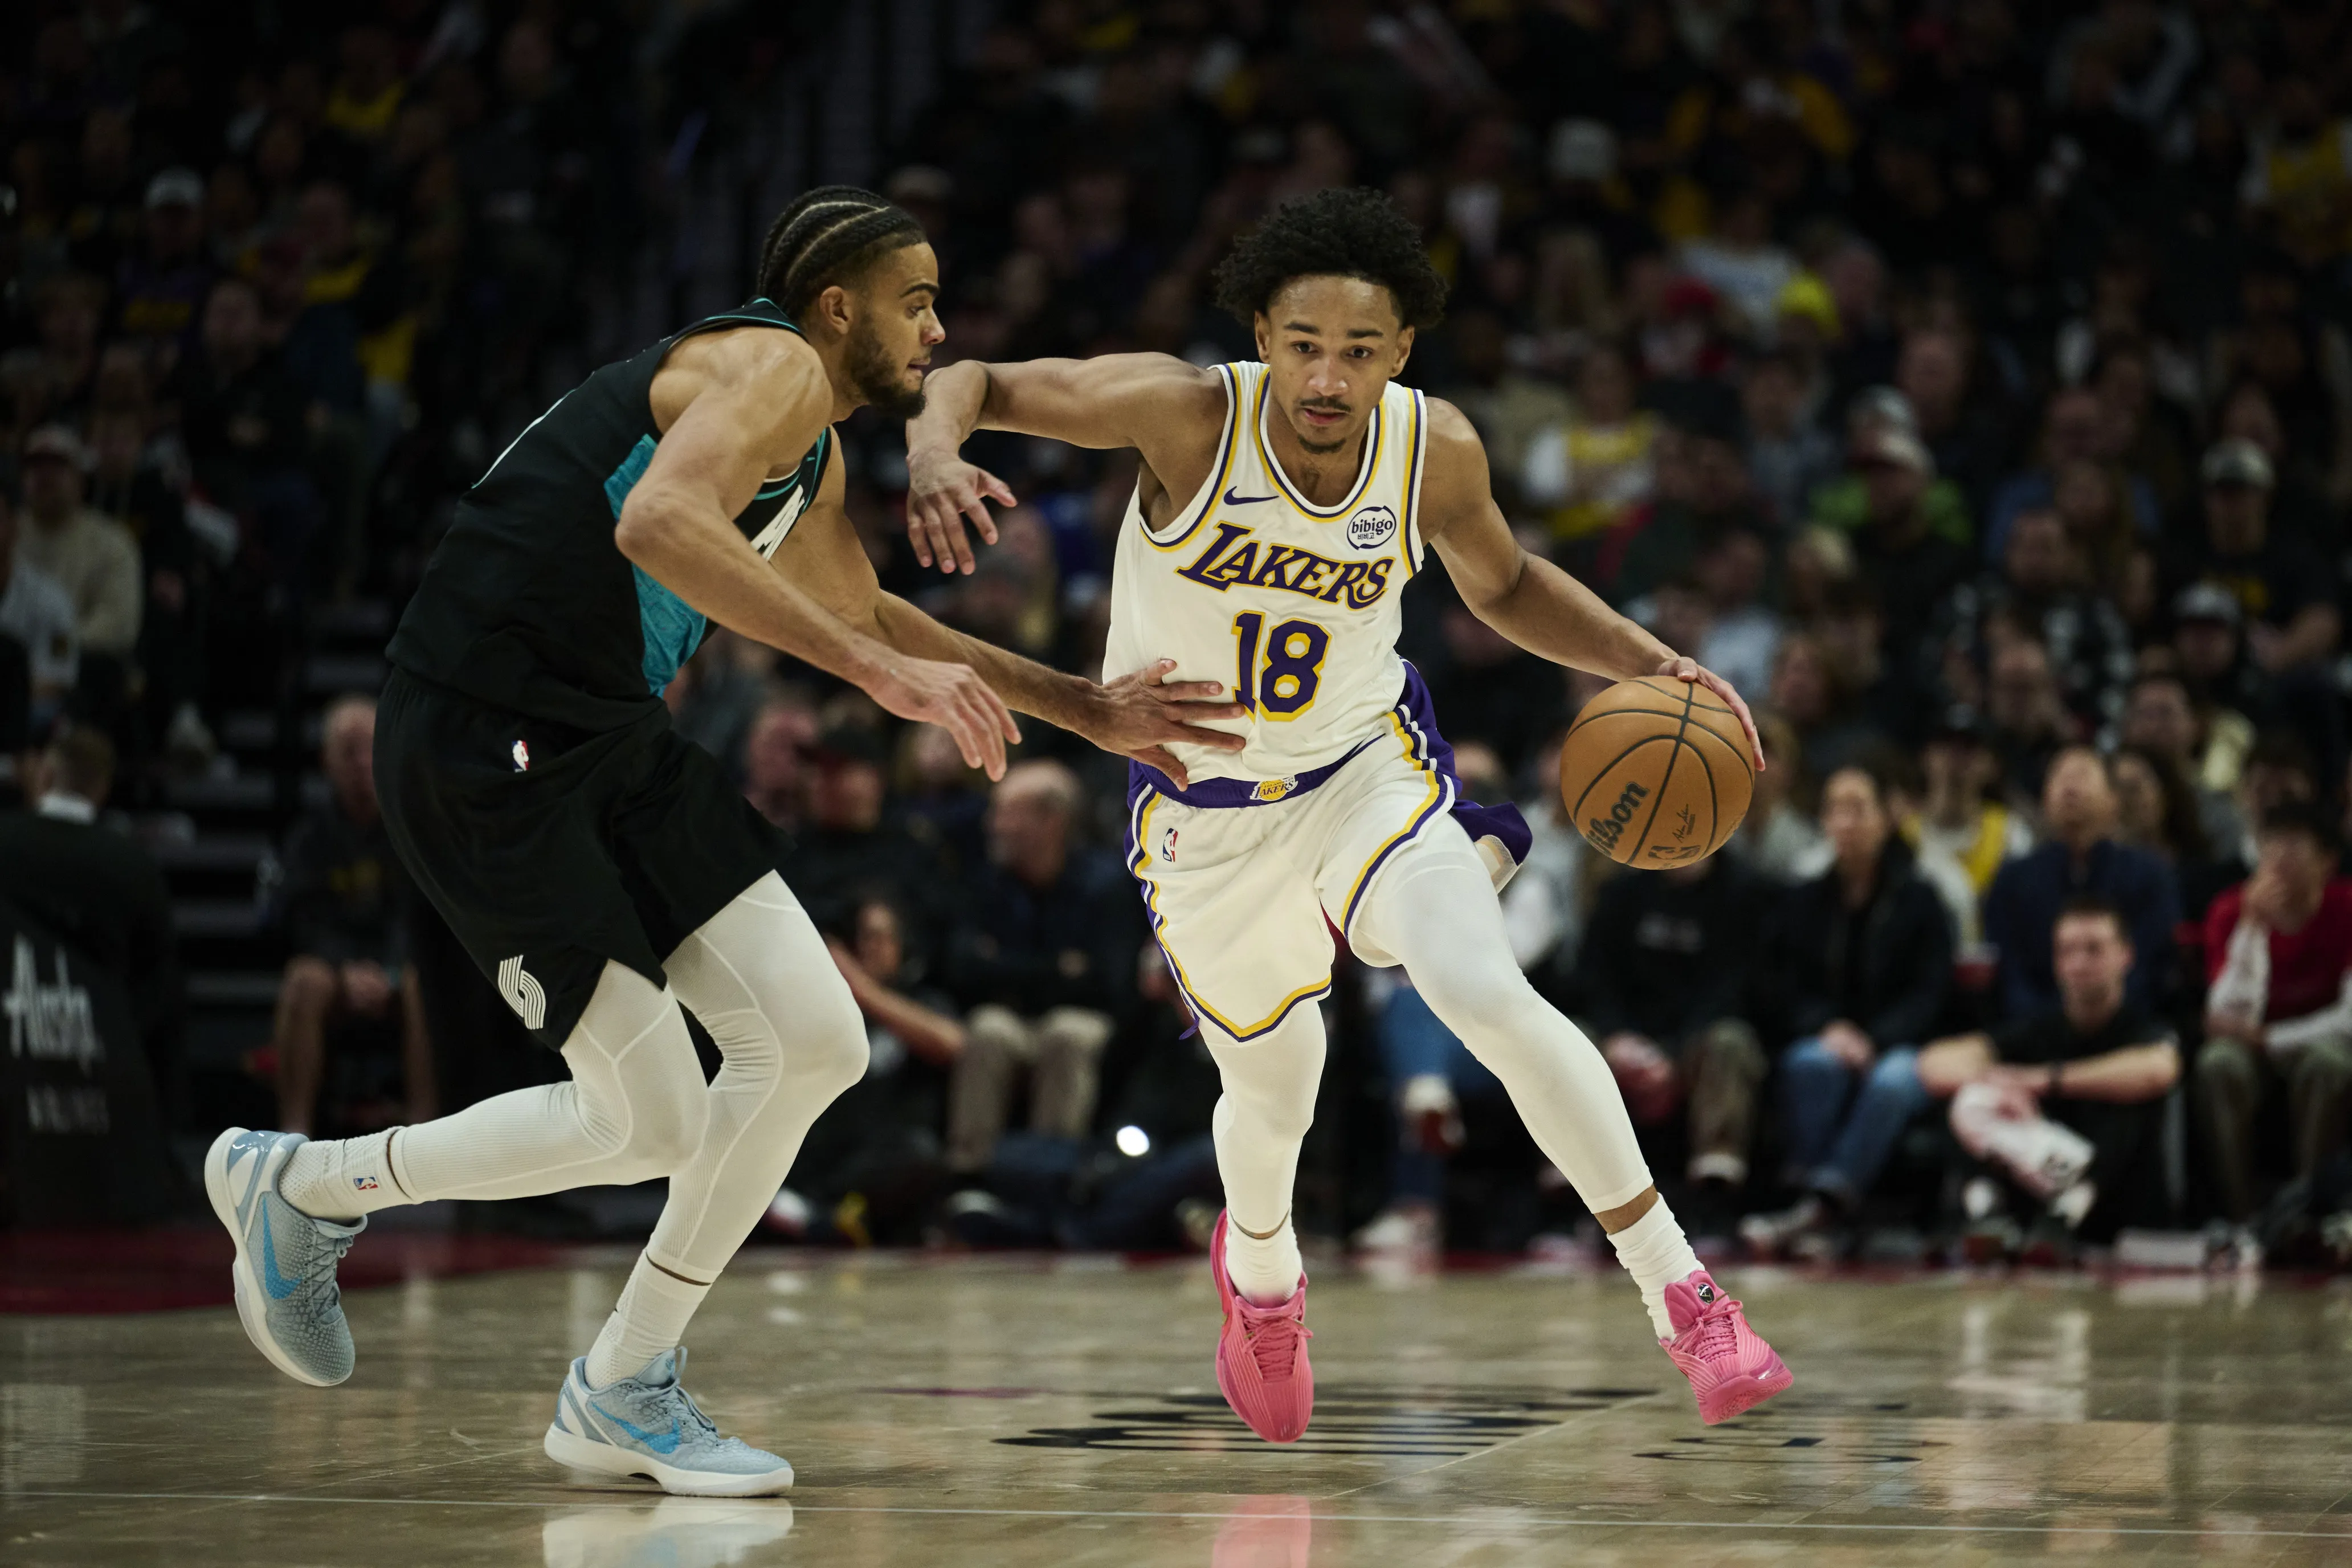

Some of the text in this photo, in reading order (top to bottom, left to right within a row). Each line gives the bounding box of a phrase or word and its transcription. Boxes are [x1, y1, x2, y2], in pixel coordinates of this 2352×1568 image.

[1351, 517, 1393, 535] bibigo
[1175, 520, 1396, 610] LAKERS
[1231, 610, 1332, 722] 18
[1255, 780, 1294, 799] LAKERS
